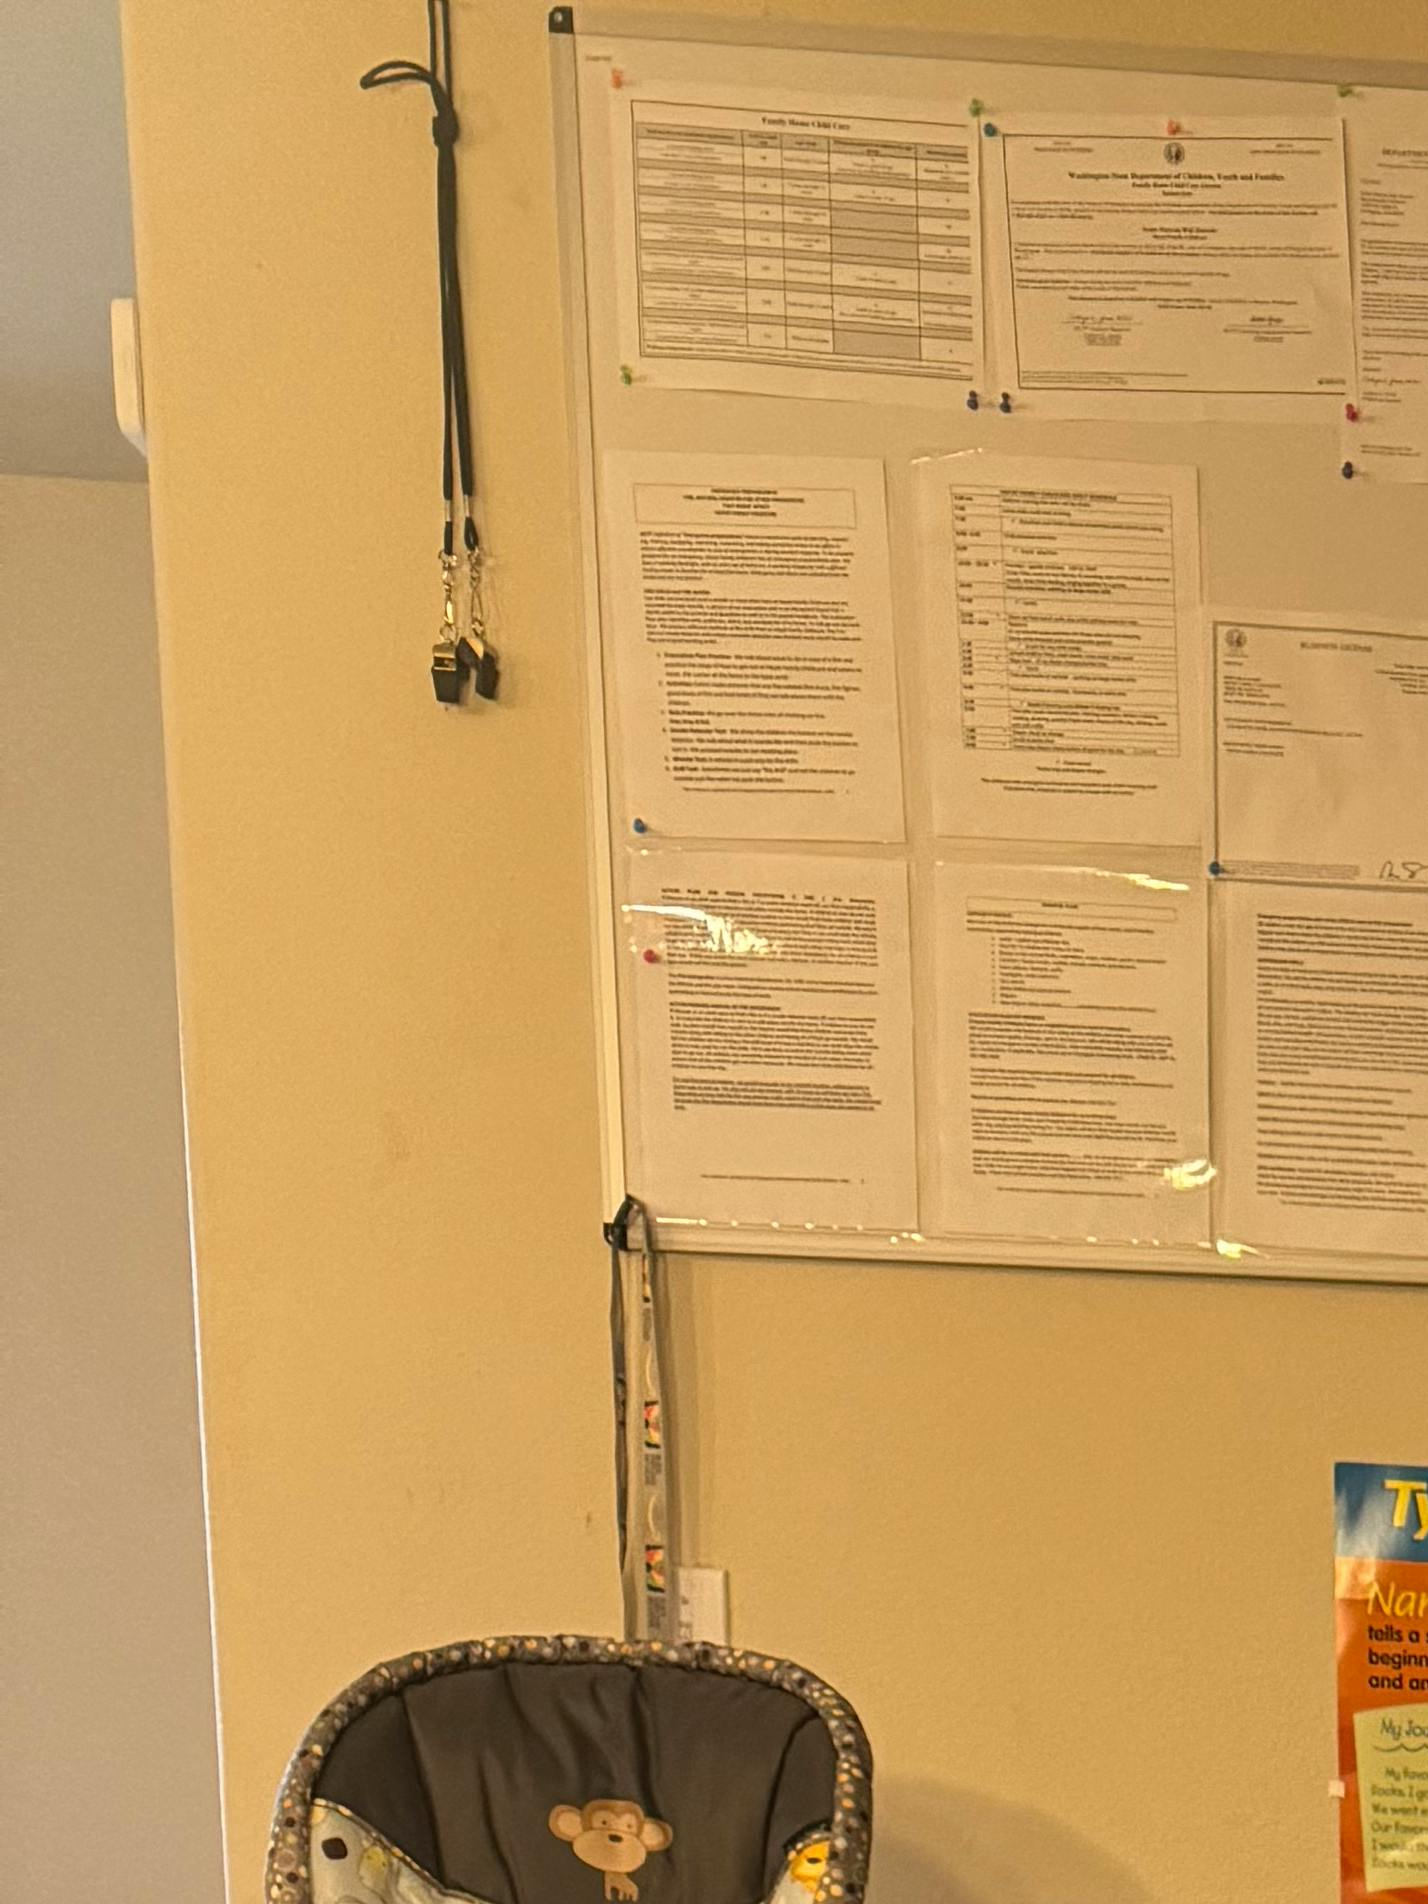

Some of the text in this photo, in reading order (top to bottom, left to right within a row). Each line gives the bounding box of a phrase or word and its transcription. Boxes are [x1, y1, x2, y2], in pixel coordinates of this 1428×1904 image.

[1368, 1626, 1402, 1643] tells
[1408, 1632, 1419, 1643] a
[1368, 1674, 1403, 1690] and
[1381, 1718, 1402, 1740] My
